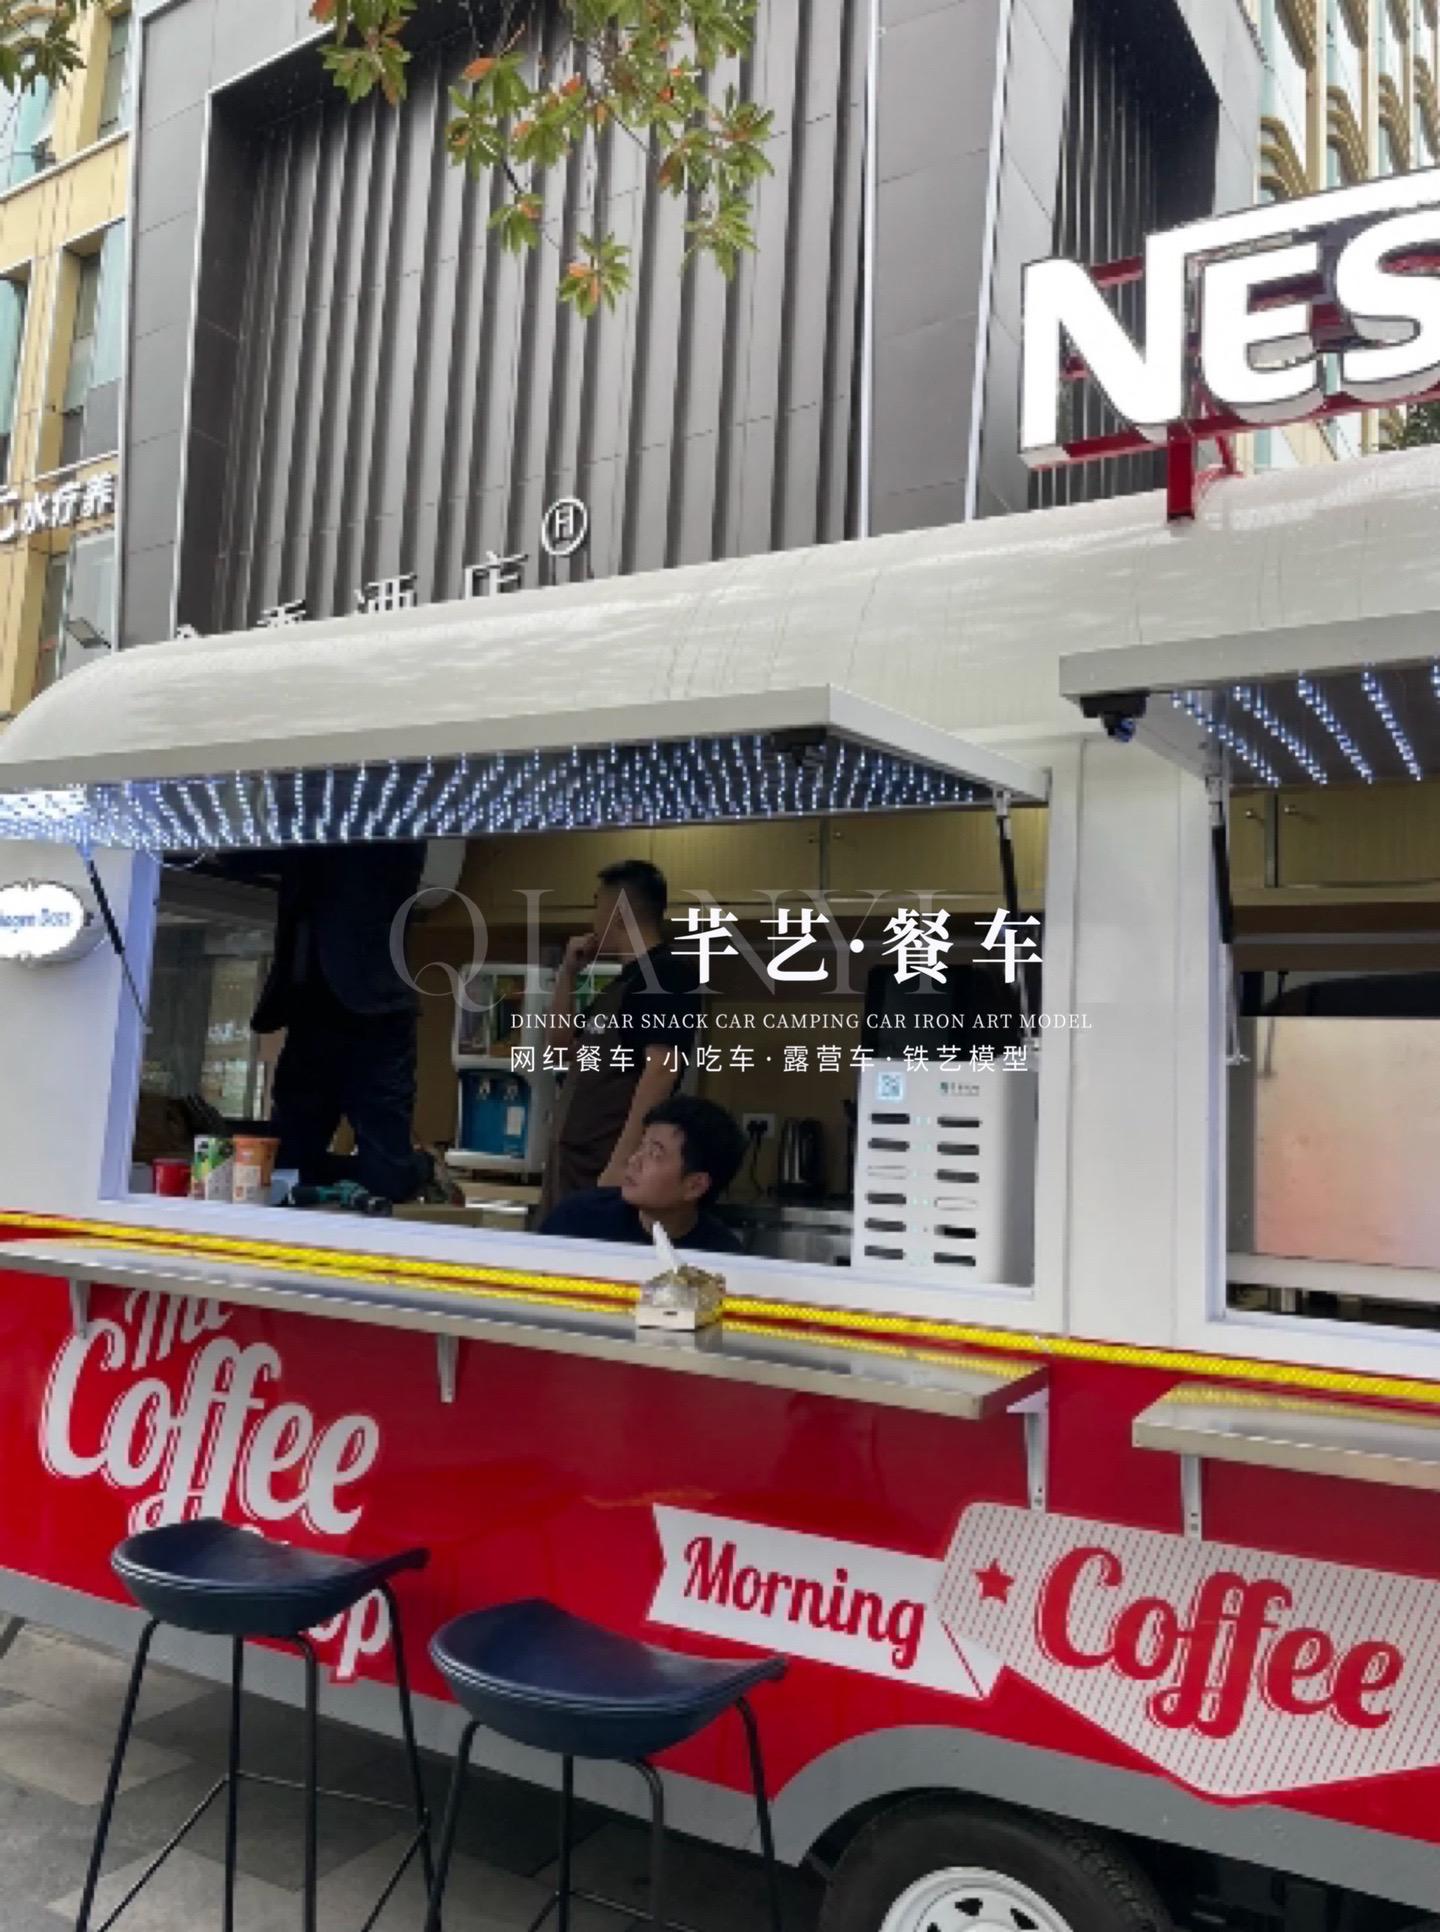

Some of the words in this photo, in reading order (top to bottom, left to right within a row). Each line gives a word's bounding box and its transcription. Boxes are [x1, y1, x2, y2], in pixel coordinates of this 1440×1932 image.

[1020, 167, 1440, 452] NES
[38, 1319, 381, 1536] Coffee
[684, 1536, 925, 1670] Morning
[1034, 1546, 1404, 1739] Coffee
